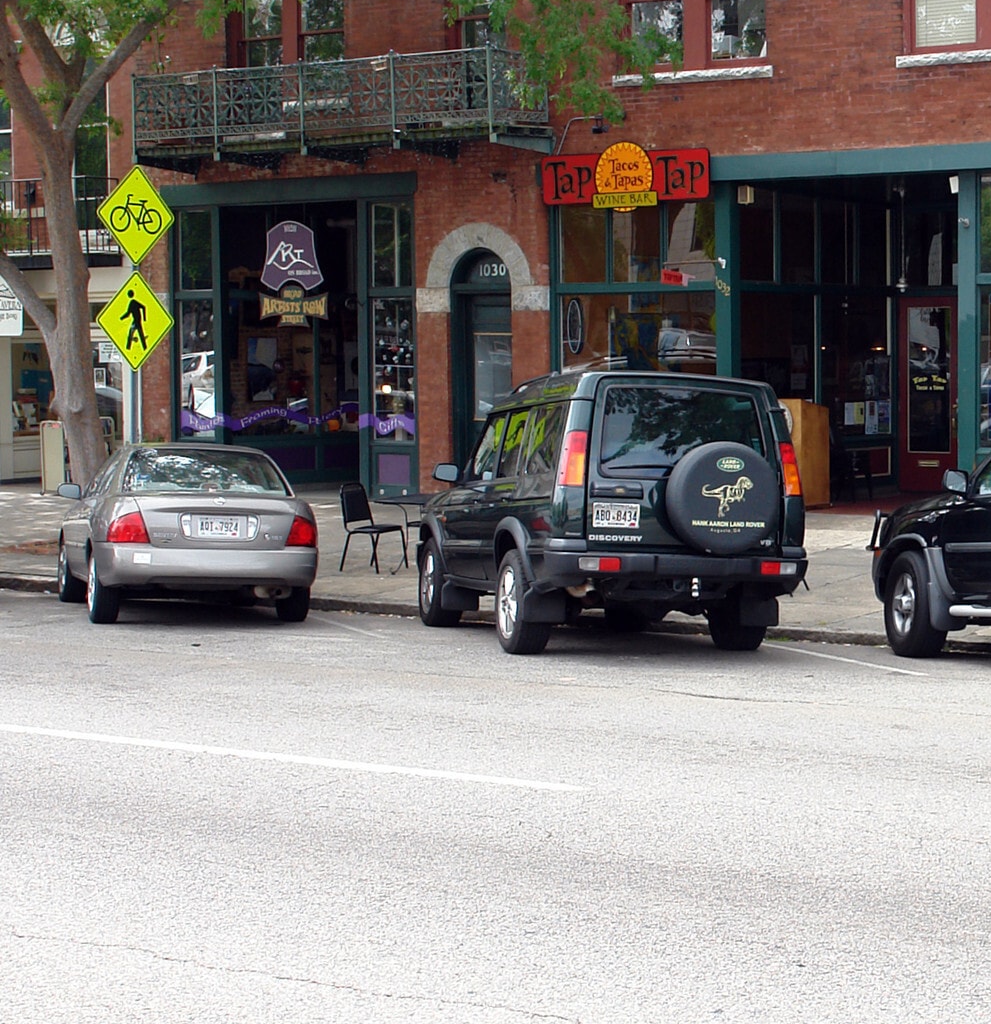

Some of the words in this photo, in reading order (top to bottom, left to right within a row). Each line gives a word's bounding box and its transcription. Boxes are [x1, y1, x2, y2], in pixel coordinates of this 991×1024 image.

[608, 158, 640, 174] Tacos
[545, 161, 593, 200] Tap
[611, 174, 644, 190] Tapas
[654, 155, 705, 196] Tap
[595, 194, 626, 206] WINE
[630, 192, 653, 204] BAR
[480, 263, 507, 277] 1030
[715, 276, 731, 296] 1032
[303, 296, 326, 316] ROW
[240, 407, 288, 428] Framing
[729, 520, 745, 528] LAND
[588, 534, 643, 542] DISCOVERY
